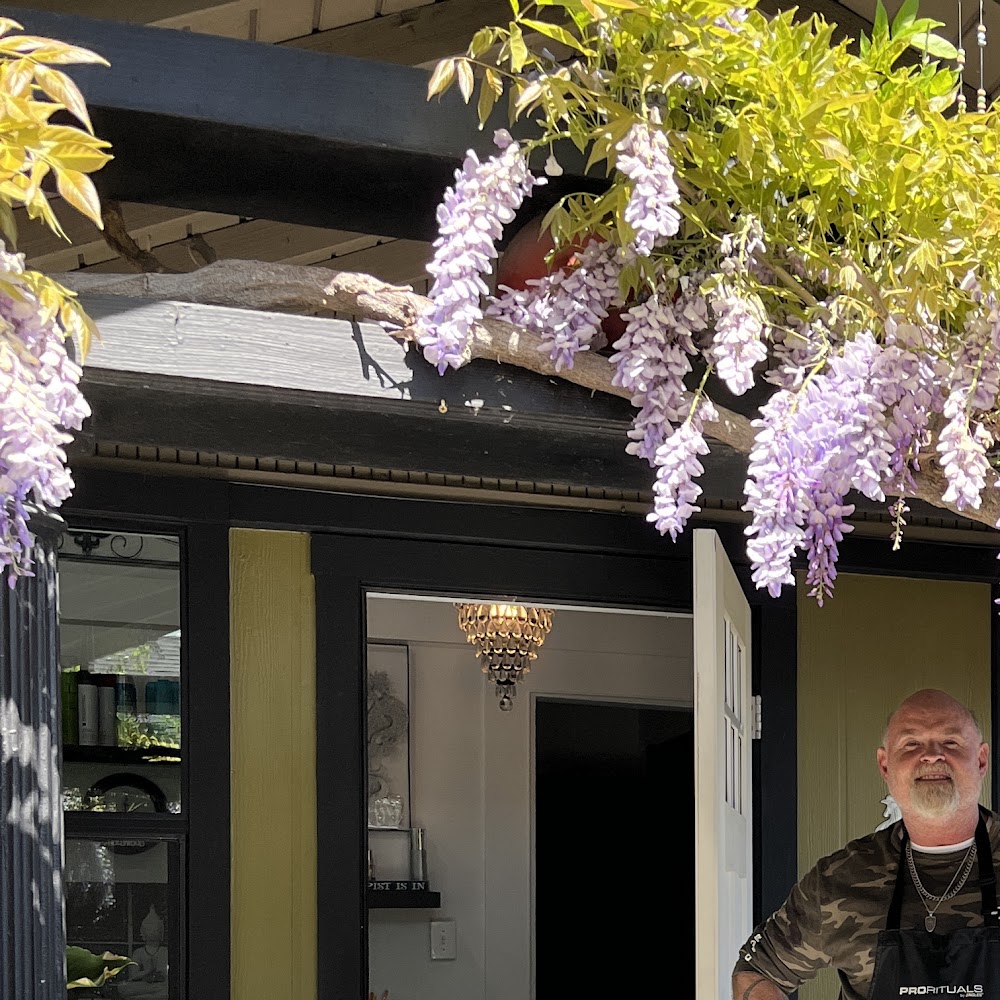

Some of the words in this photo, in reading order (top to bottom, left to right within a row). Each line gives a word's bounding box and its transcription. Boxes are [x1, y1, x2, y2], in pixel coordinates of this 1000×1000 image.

[396, 882, 408, 891] IS
[412, 882, 425, 891] IN
[899, 984, 984, 995] PRORITUALS
